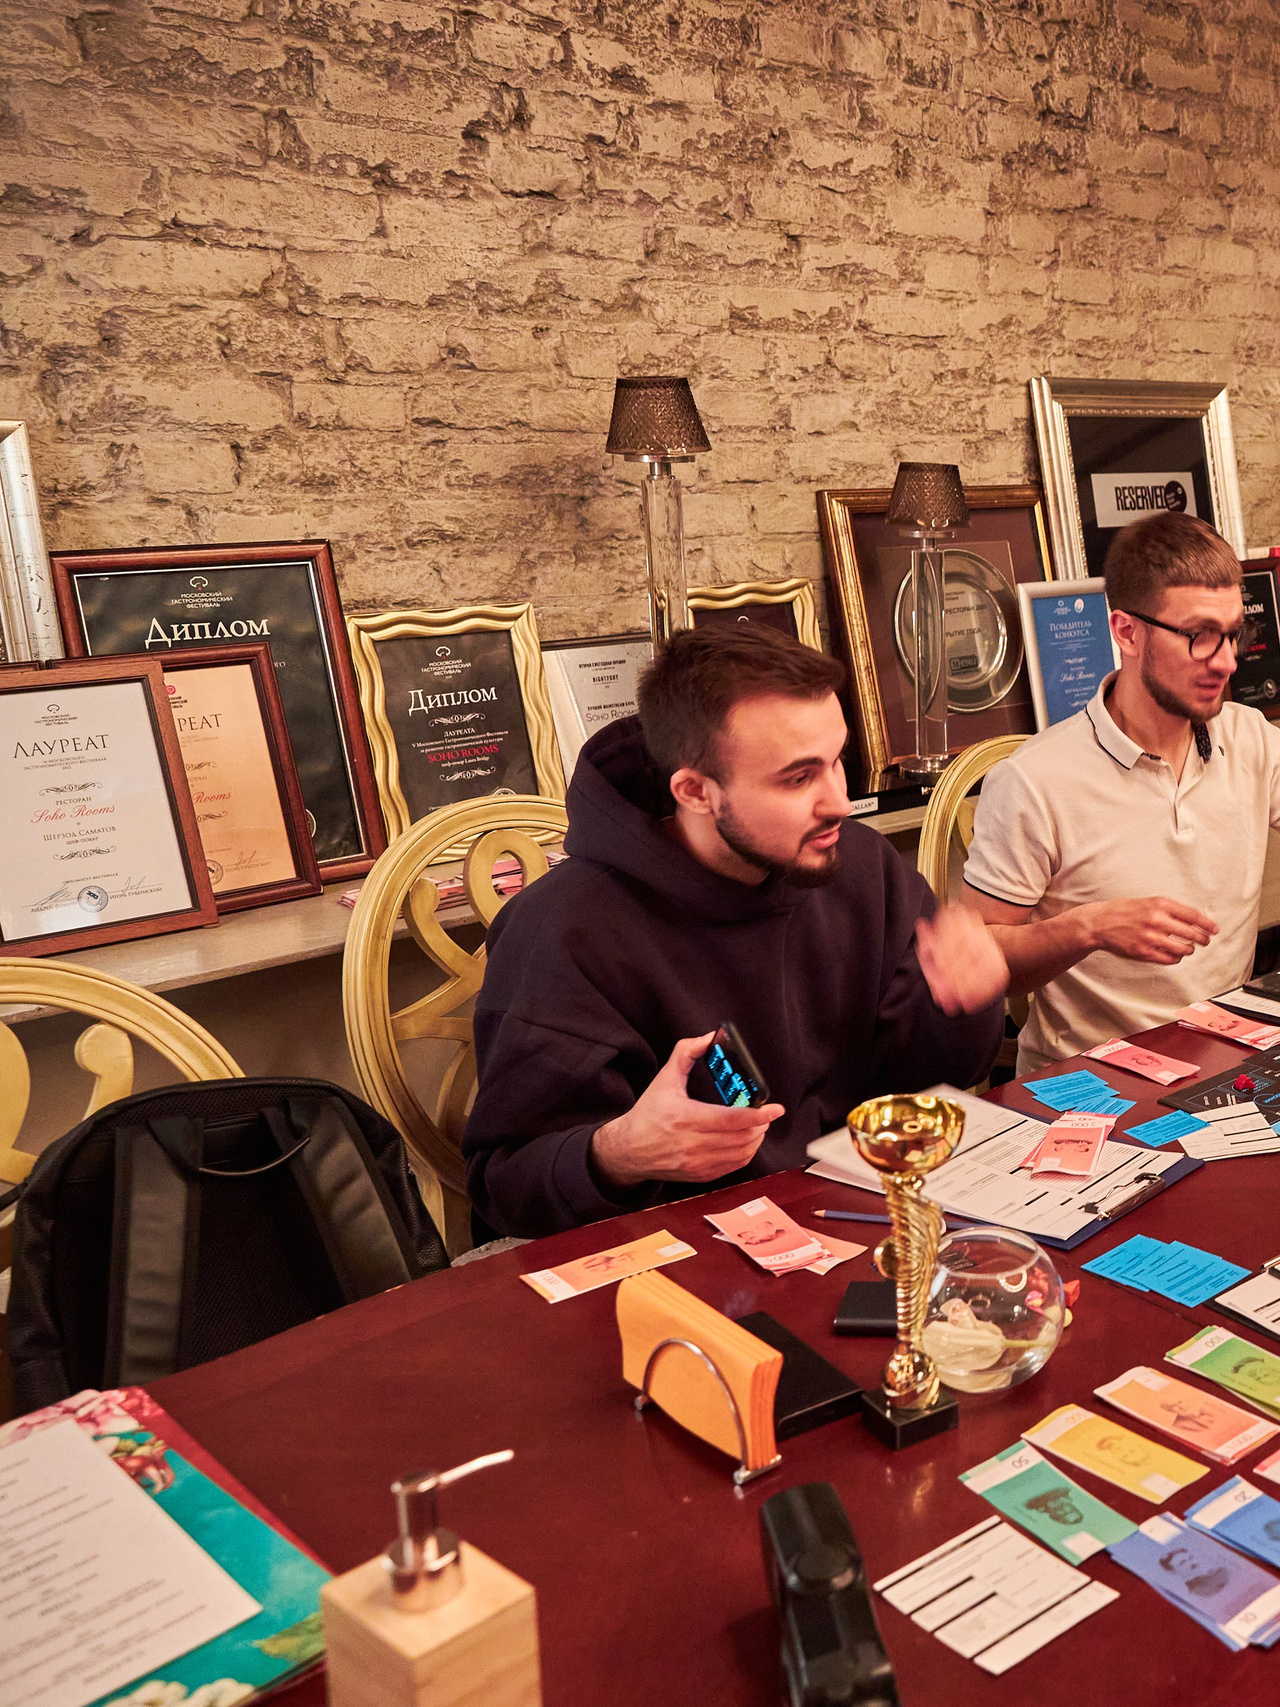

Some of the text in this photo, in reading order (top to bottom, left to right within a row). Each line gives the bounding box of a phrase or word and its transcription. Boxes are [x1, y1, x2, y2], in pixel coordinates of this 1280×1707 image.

[171, 596, 233, 605] ГАСТРОНОМИЧЕСКИЙ
[181, 591, 222, 599] МОСКОВСКИЙ
[1054, 629, 1090, 639] КОНКУРСА
[421, 662, 472, 673] ГАСТРОНОМИЧЕСКИЙ
[429, 659, 463, 667] МОСКОВСКИЙ
[177, 713, 222, 732] РЕАТ
[443, 727, 476, 737] ЛАУРЕАТА
[13, 734, 109, 759] ЛАУРЕАТ
[427, 744, 499, 763] SOHO ROOMS
[55, 796, 92, 806] РЕСТОРАН
[30, 804, 115, 824] Soho Rooms
[1205, 1335, 1225, 1348] 100
[1011, 1455, 1029, 1469] 50
